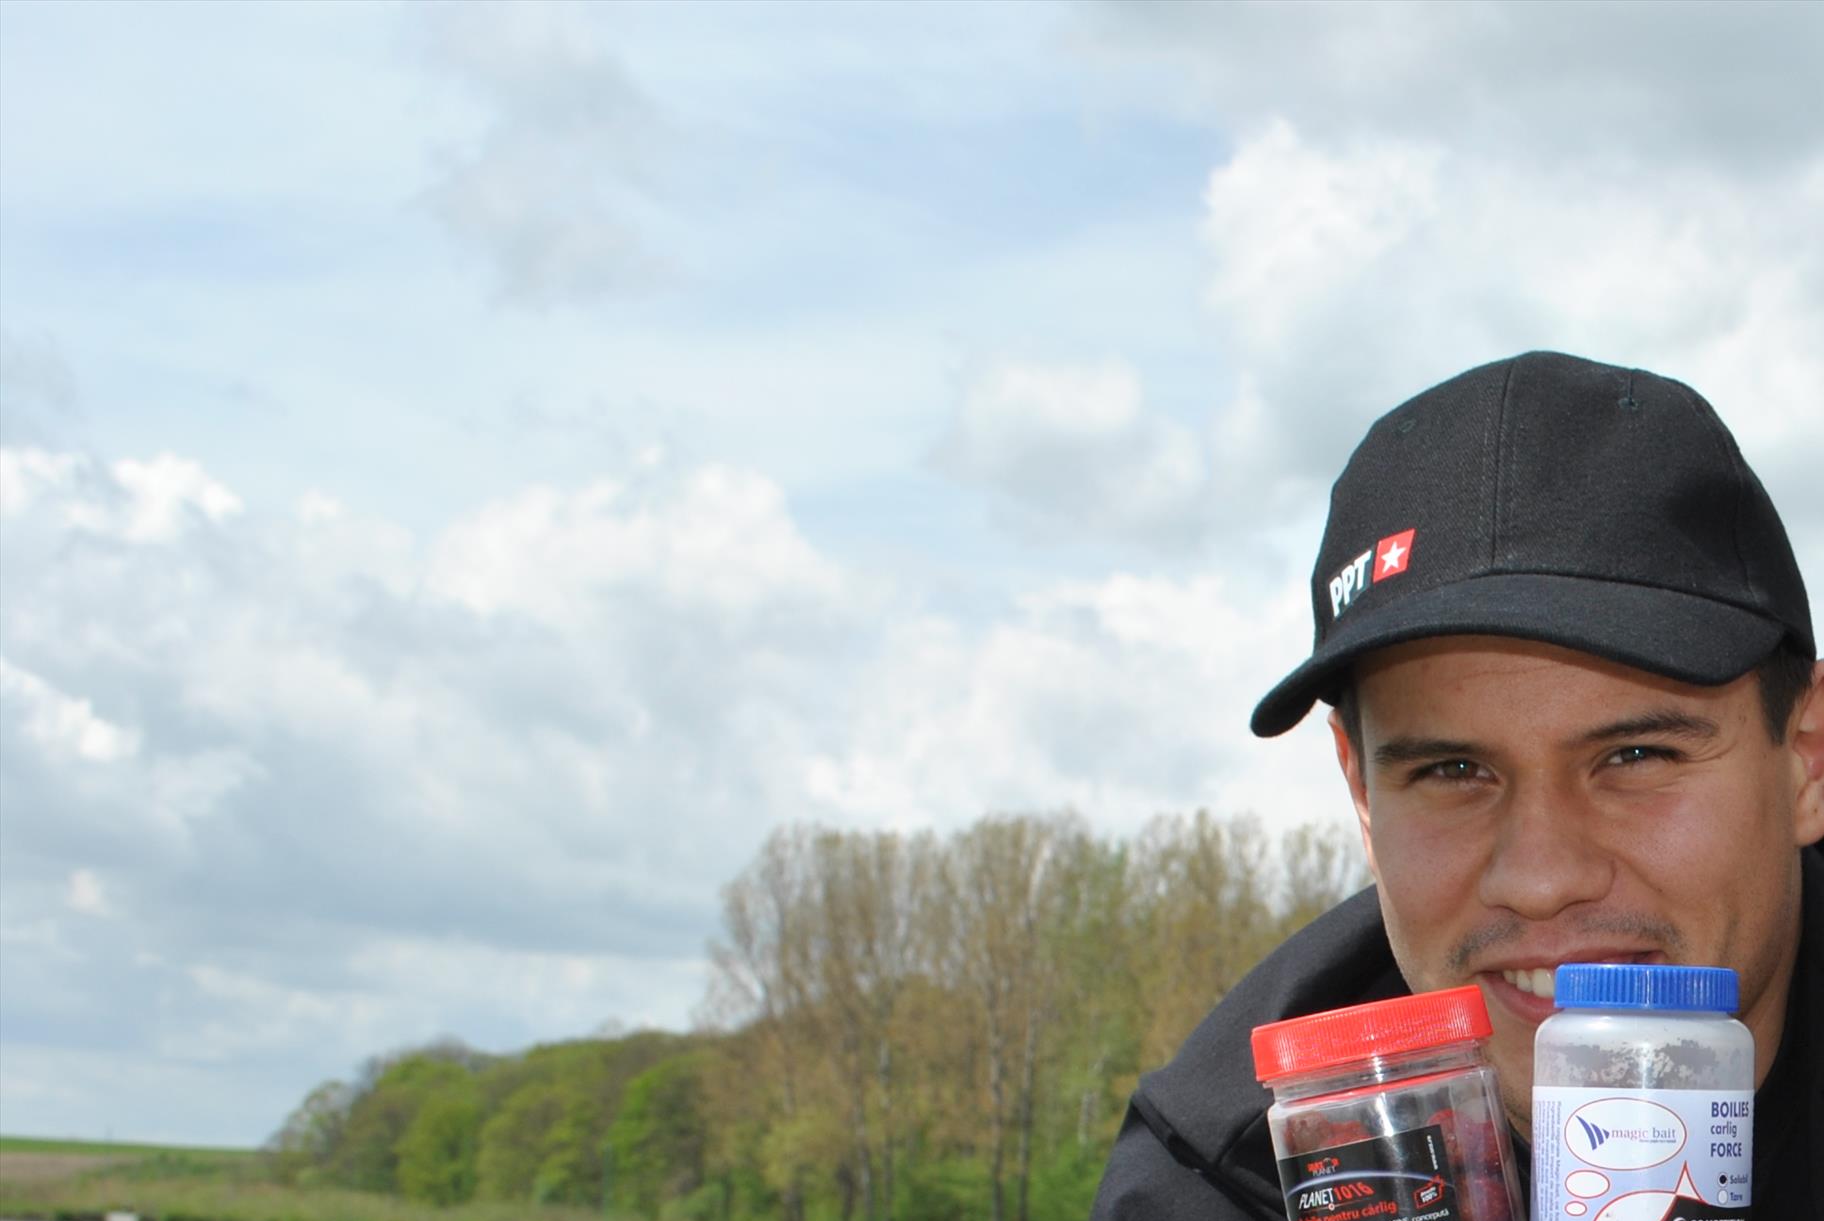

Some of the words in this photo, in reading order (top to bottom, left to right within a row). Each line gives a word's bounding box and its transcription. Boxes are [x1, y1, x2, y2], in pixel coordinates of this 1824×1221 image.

[1329, 549, 1372, 618] PPT
[1711, 1101, 1749, 1118] BOILIES
[1611, 1128, 1649, 1140] magic
[1652, 1127, 1676, 1138] bait
[1711, 1122, 1737, 1138] carlig
[1711, 1143, 1742, 1157] FORCE
